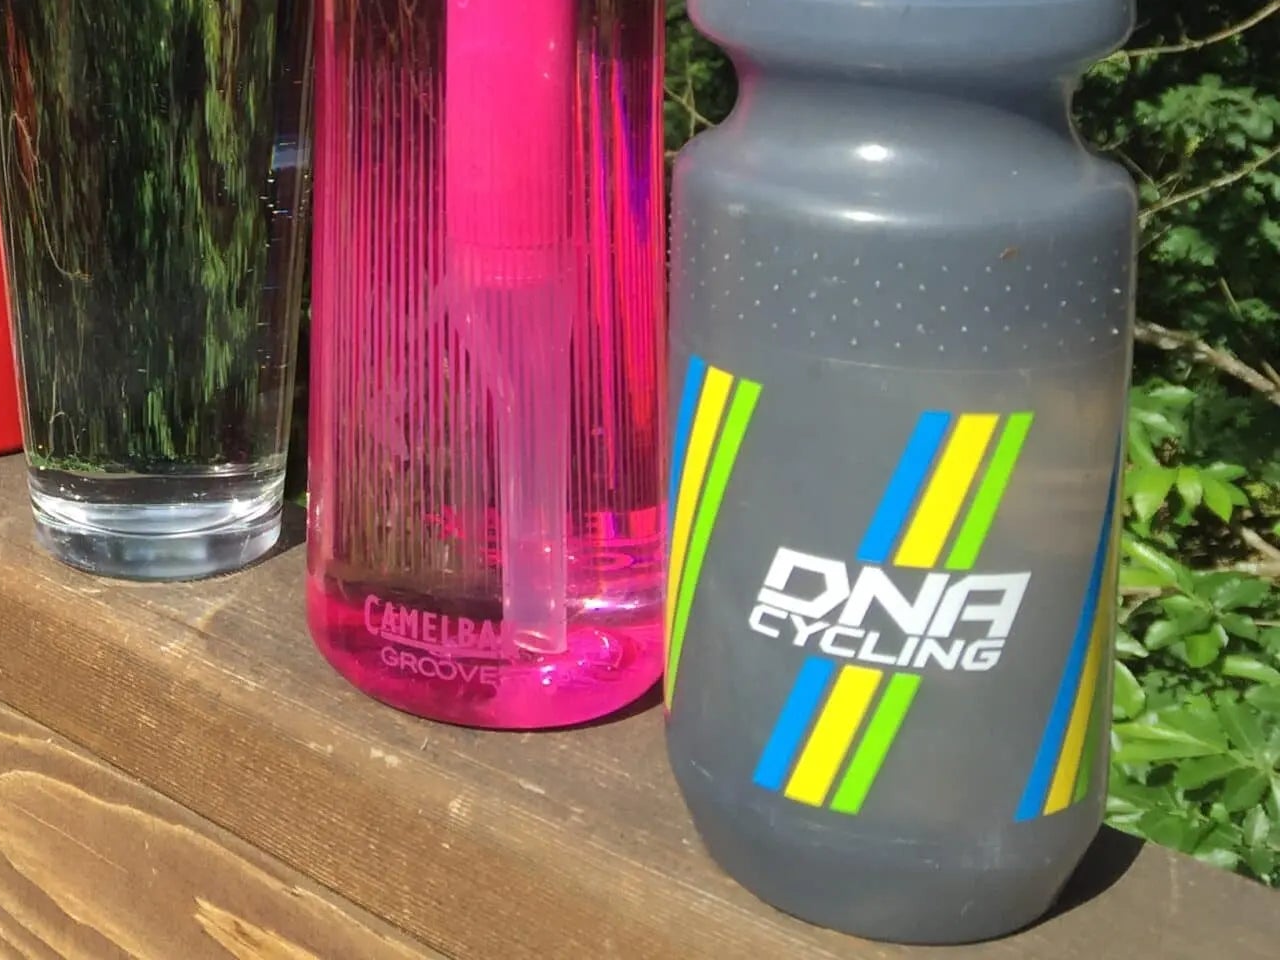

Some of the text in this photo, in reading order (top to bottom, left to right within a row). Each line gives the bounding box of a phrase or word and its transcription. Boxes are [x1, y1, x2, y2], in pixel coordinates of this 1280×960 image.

[757, 546, 1031, 638] DNA
[380, 646, 500, 686] GROOVE
[748, 604, 1006, 671] CYCLING
